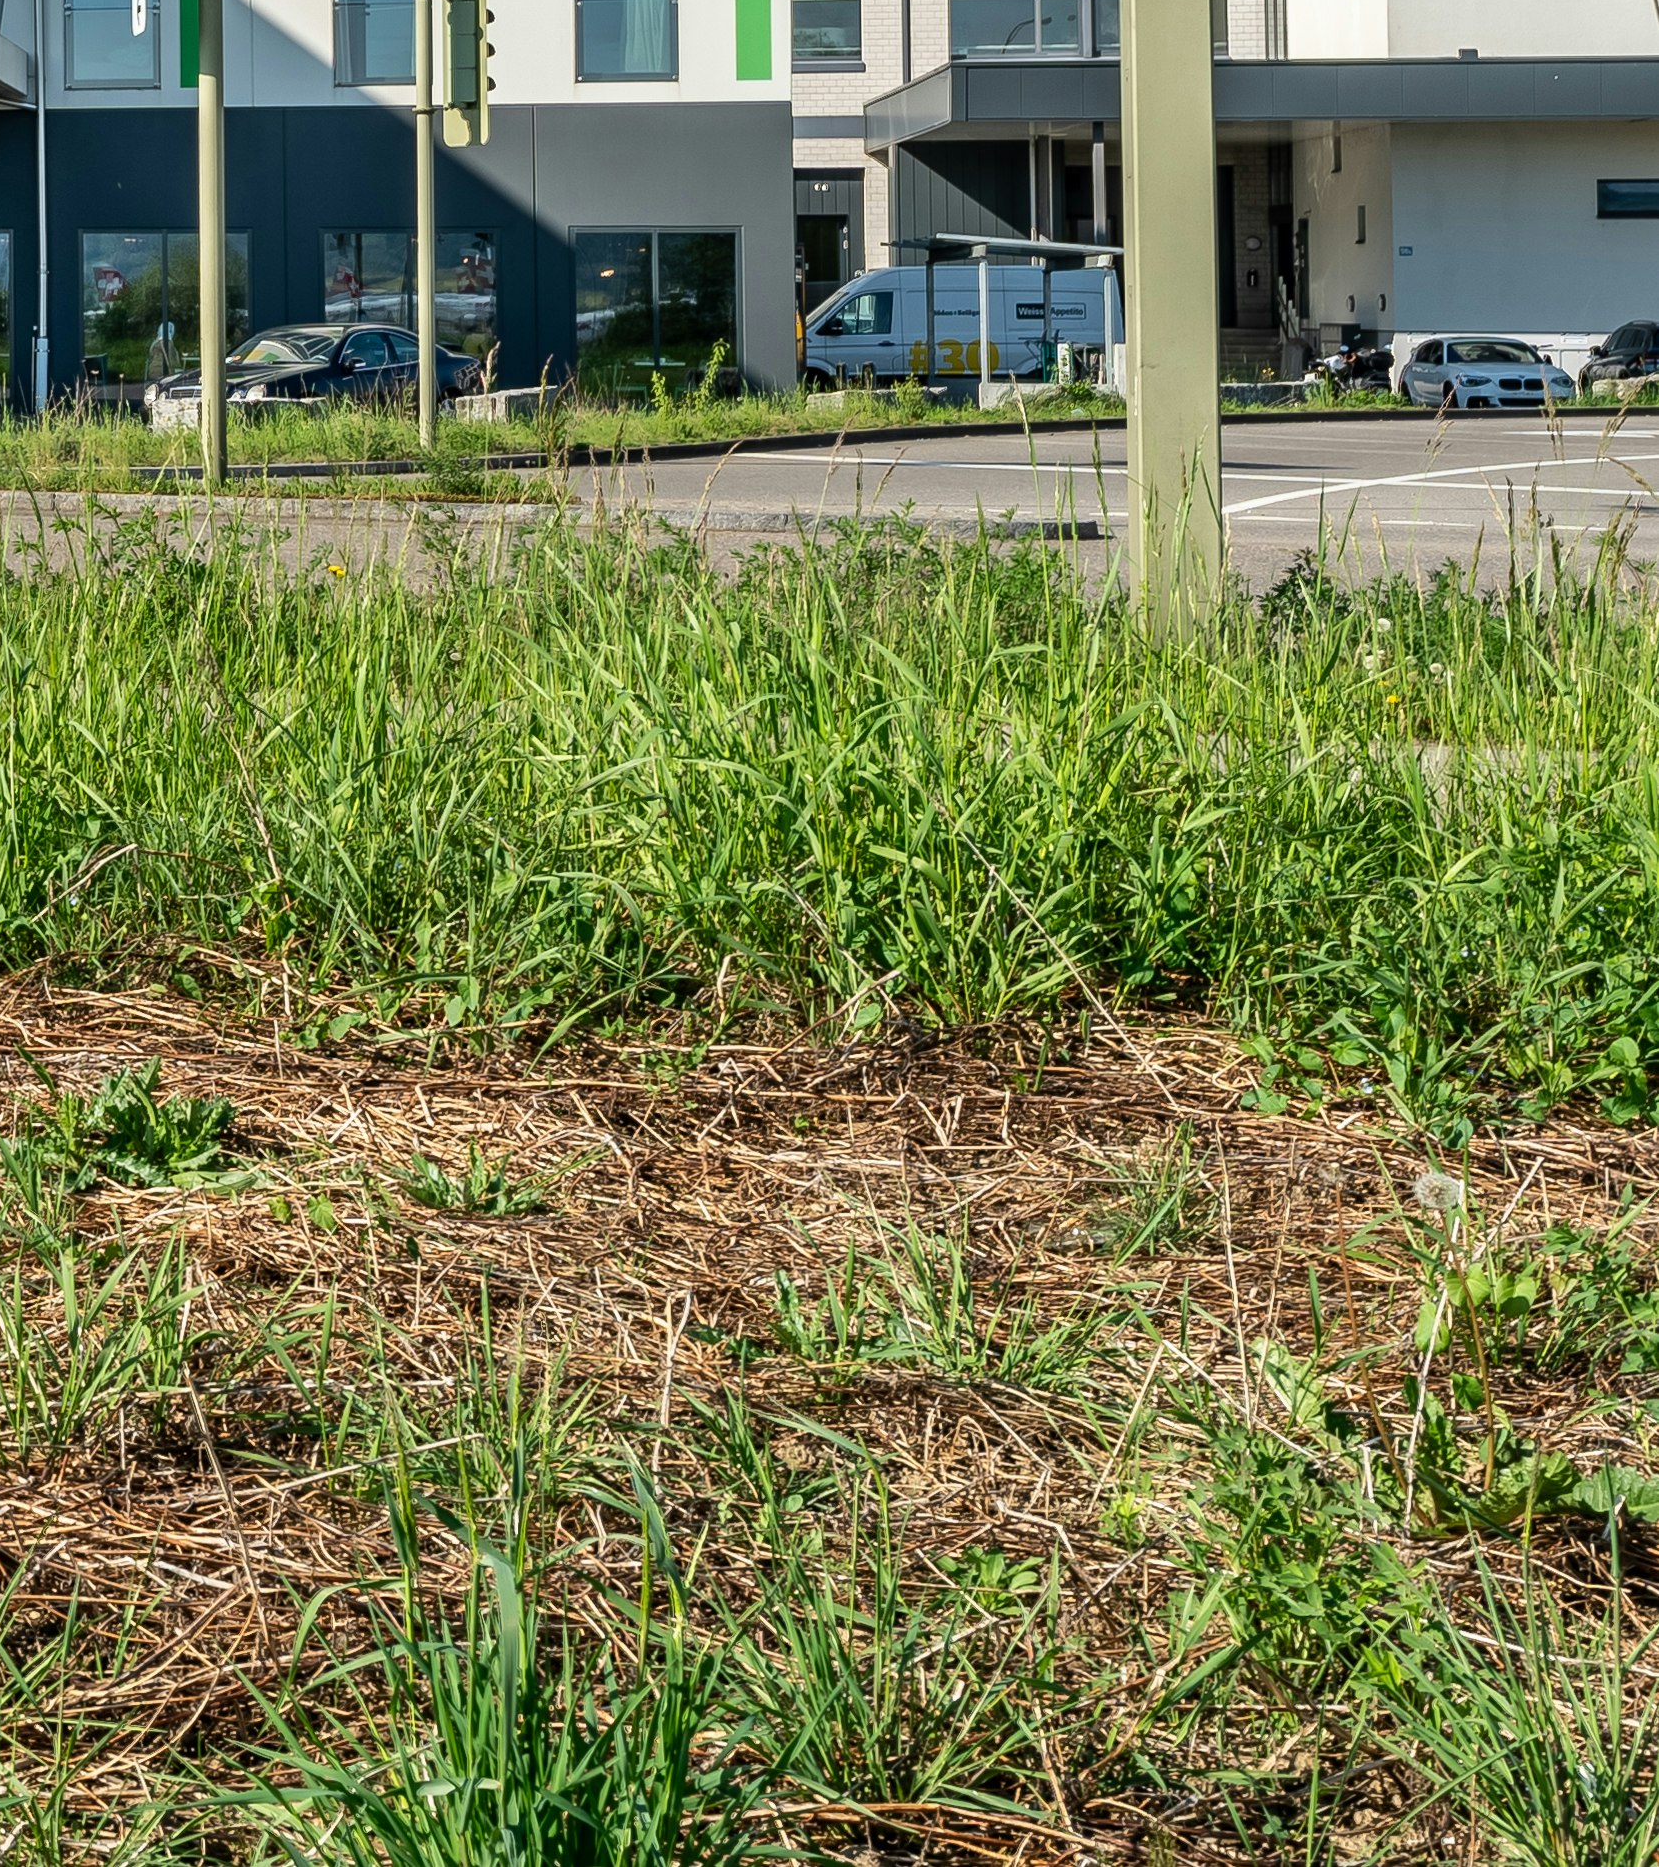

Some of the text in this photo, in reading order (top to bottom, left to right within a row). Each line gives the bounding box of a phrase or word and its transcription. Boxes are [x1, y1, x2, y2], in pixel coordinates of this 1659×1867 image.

[1017, 306, 1084, 317] Weiss Appetito
[908, 338, 1000, 375] #30
